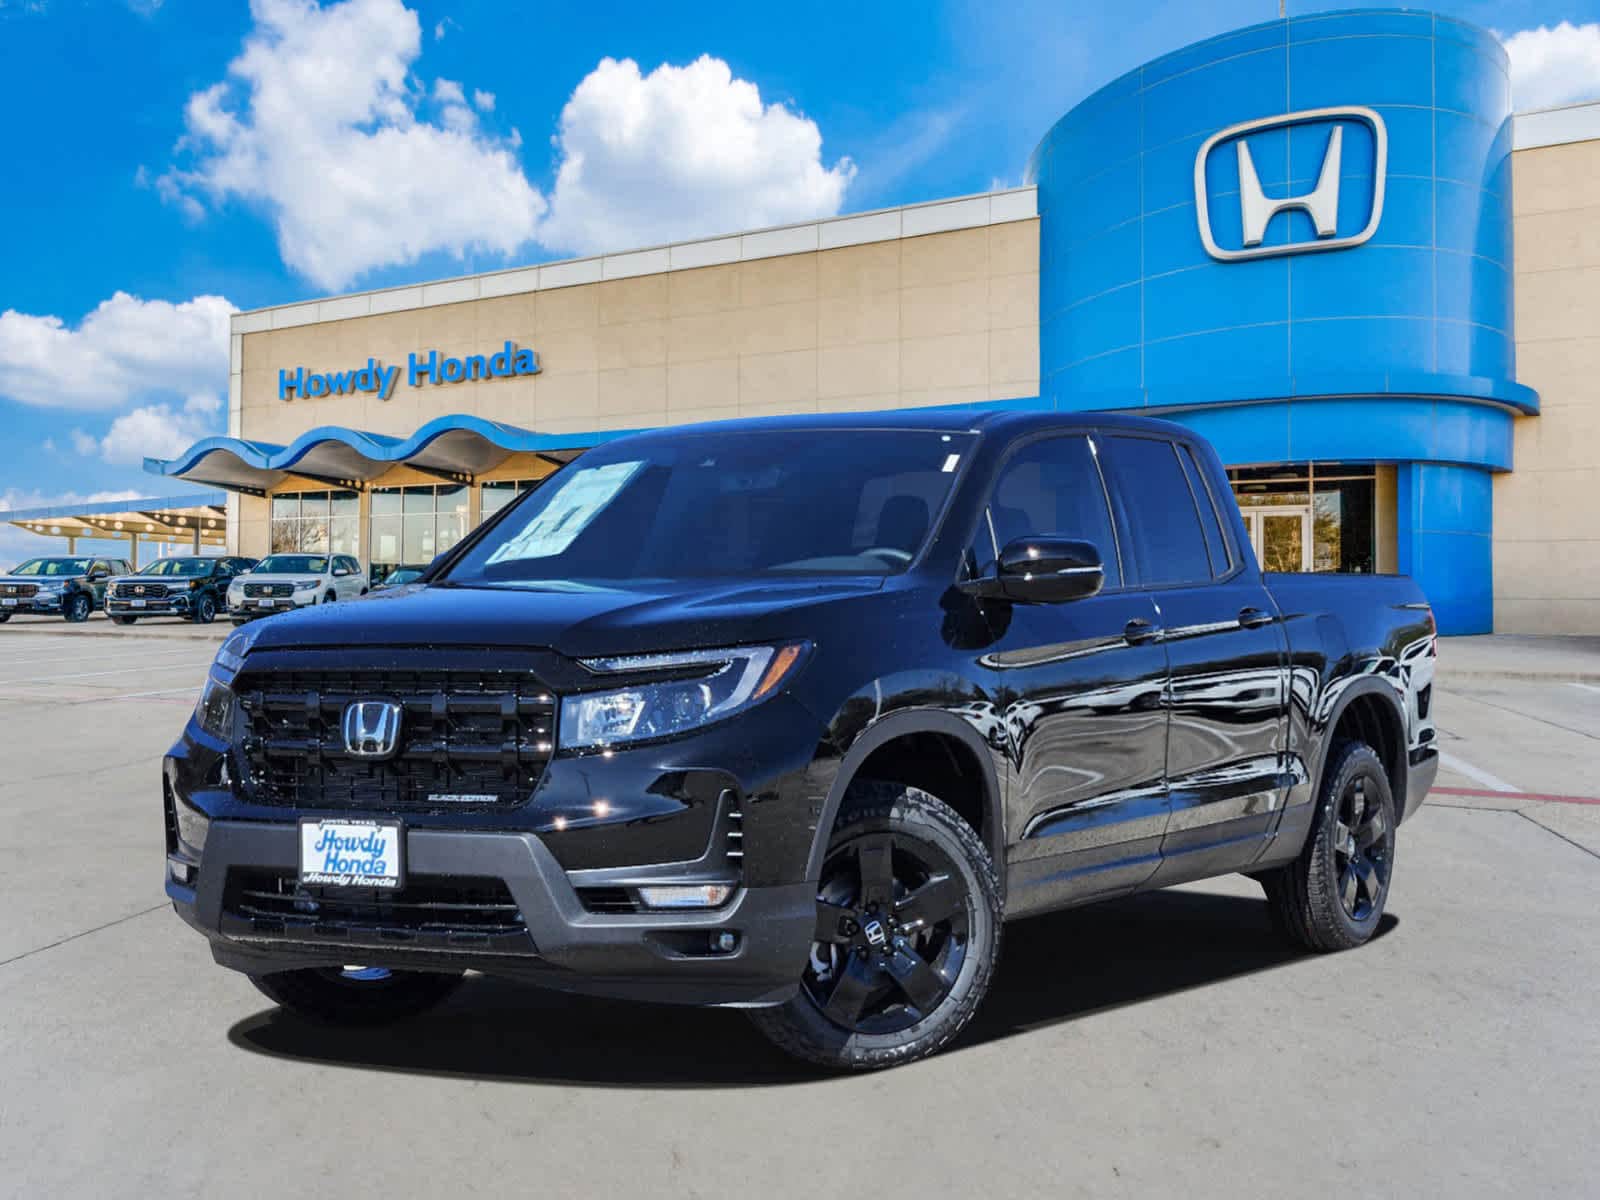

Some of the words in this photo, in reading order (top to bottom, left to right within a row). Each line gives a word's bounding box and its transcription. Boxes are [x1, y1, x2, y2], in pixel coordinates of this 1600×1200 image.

[279, 358, 399, 400] Howdy
[408, 340, 541, 386] Honda
[315, 829, 386, 858] Howdy
[324, 852, 386, 875] Honda
[303, 873, 350, 886] Howdy
[351, 875, 397, 887] Honda
